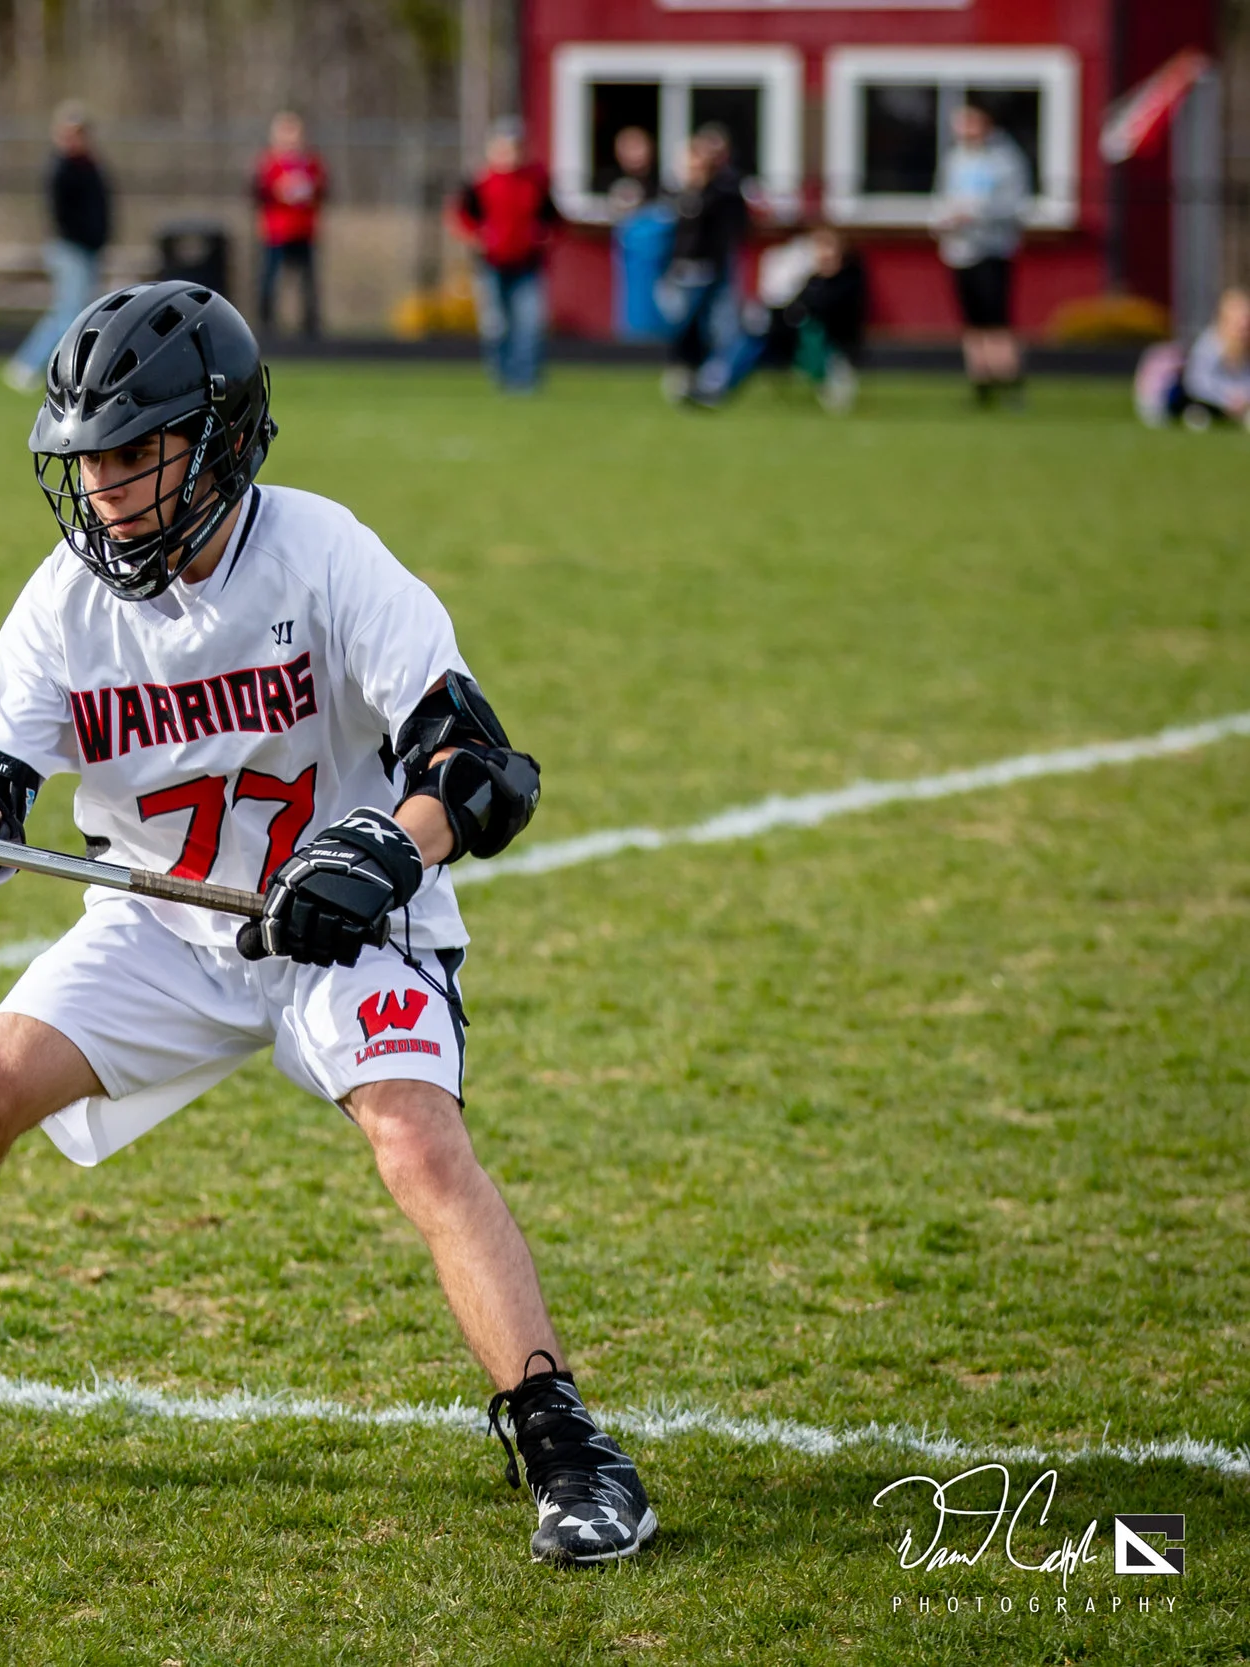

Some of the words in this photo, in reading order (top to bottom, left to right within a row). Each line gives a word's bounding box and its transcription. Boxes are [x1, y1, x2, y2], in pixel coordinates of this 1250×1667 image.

[70, 651, 318, 764] WARRIORS
[136, 762, 317, 896] 77
[310, 849, 355, 859] STALLION
[357, 988, 428, 1043] W
[355, 1038, 441, 1066] LACROSSE
